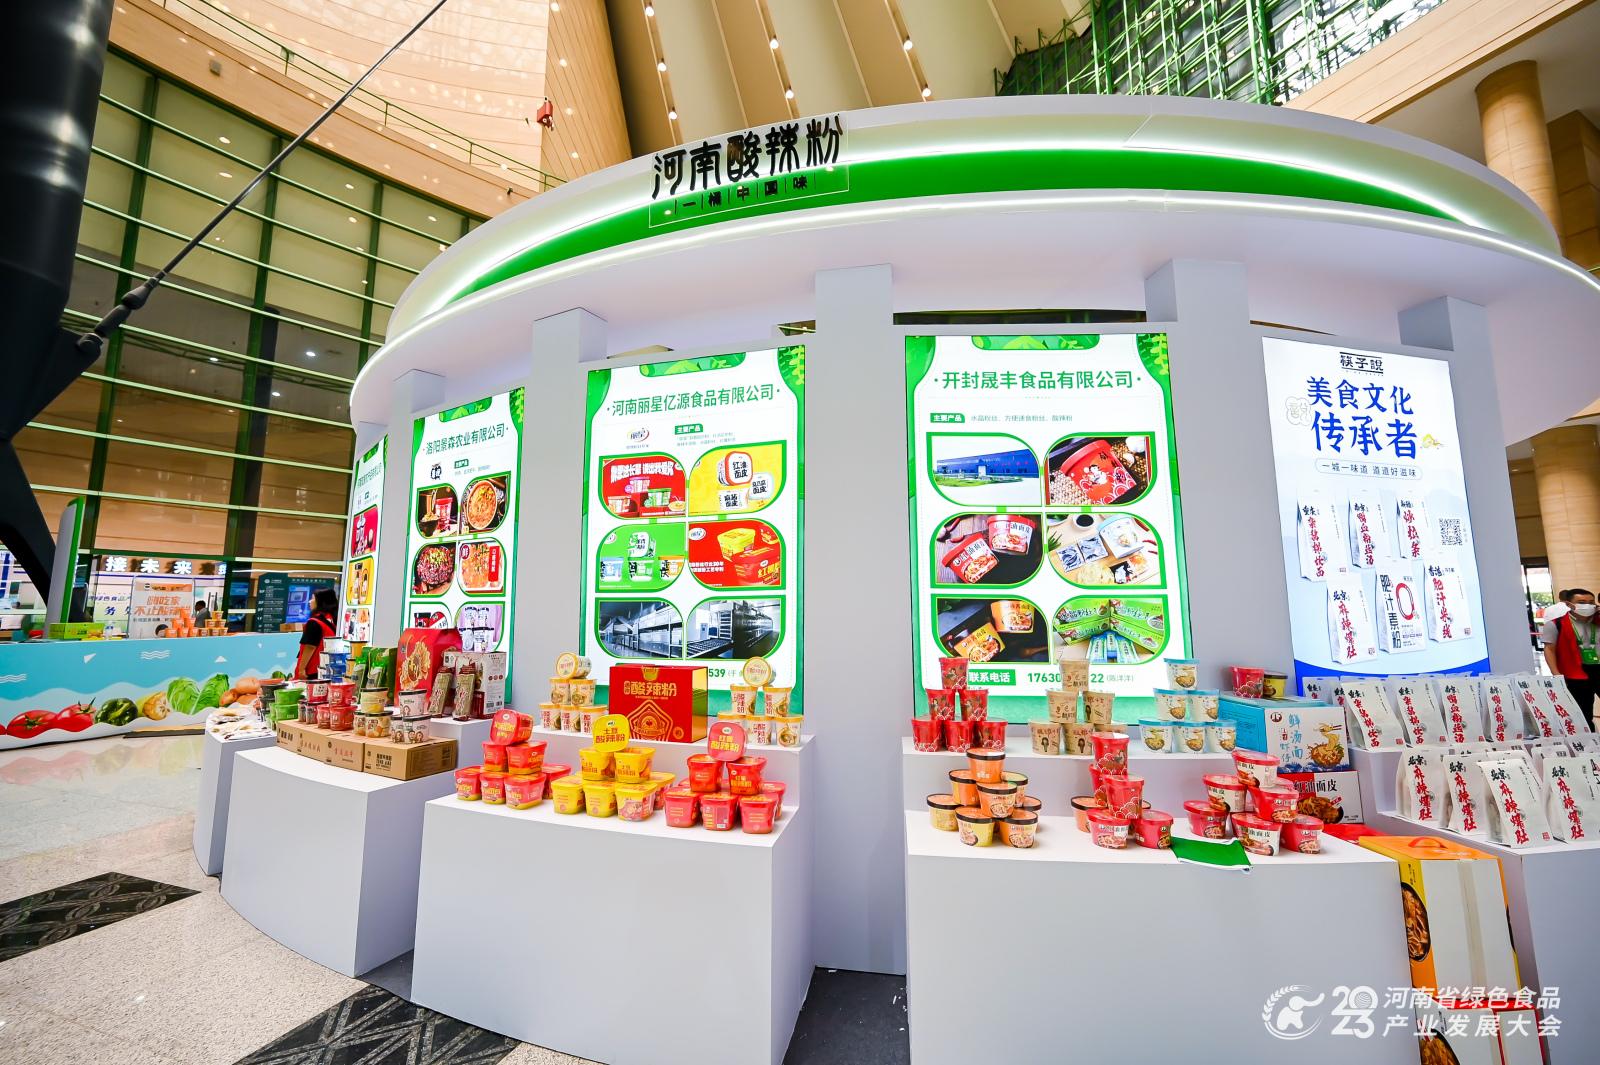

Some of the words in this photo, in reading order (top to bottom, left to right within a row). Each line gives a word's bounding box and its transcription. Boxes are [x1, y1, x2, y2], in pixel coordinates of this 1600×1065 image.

[652, 115, 843, 200] 河南酸辣粉
[942, 371, 1133, 390] 开封晟丰食品有限公司
[612, 384, 774, 416] 河南丽星亿源食品有限公司
[1307, 376, 1414, 415] 美食文化
[1311, 410, 1417, 459] 传承者
[708, 668, 726, 678] 539
[1090, 673, 1105, 684] 22
[630, 681, 677, 697] 酸辣粉
